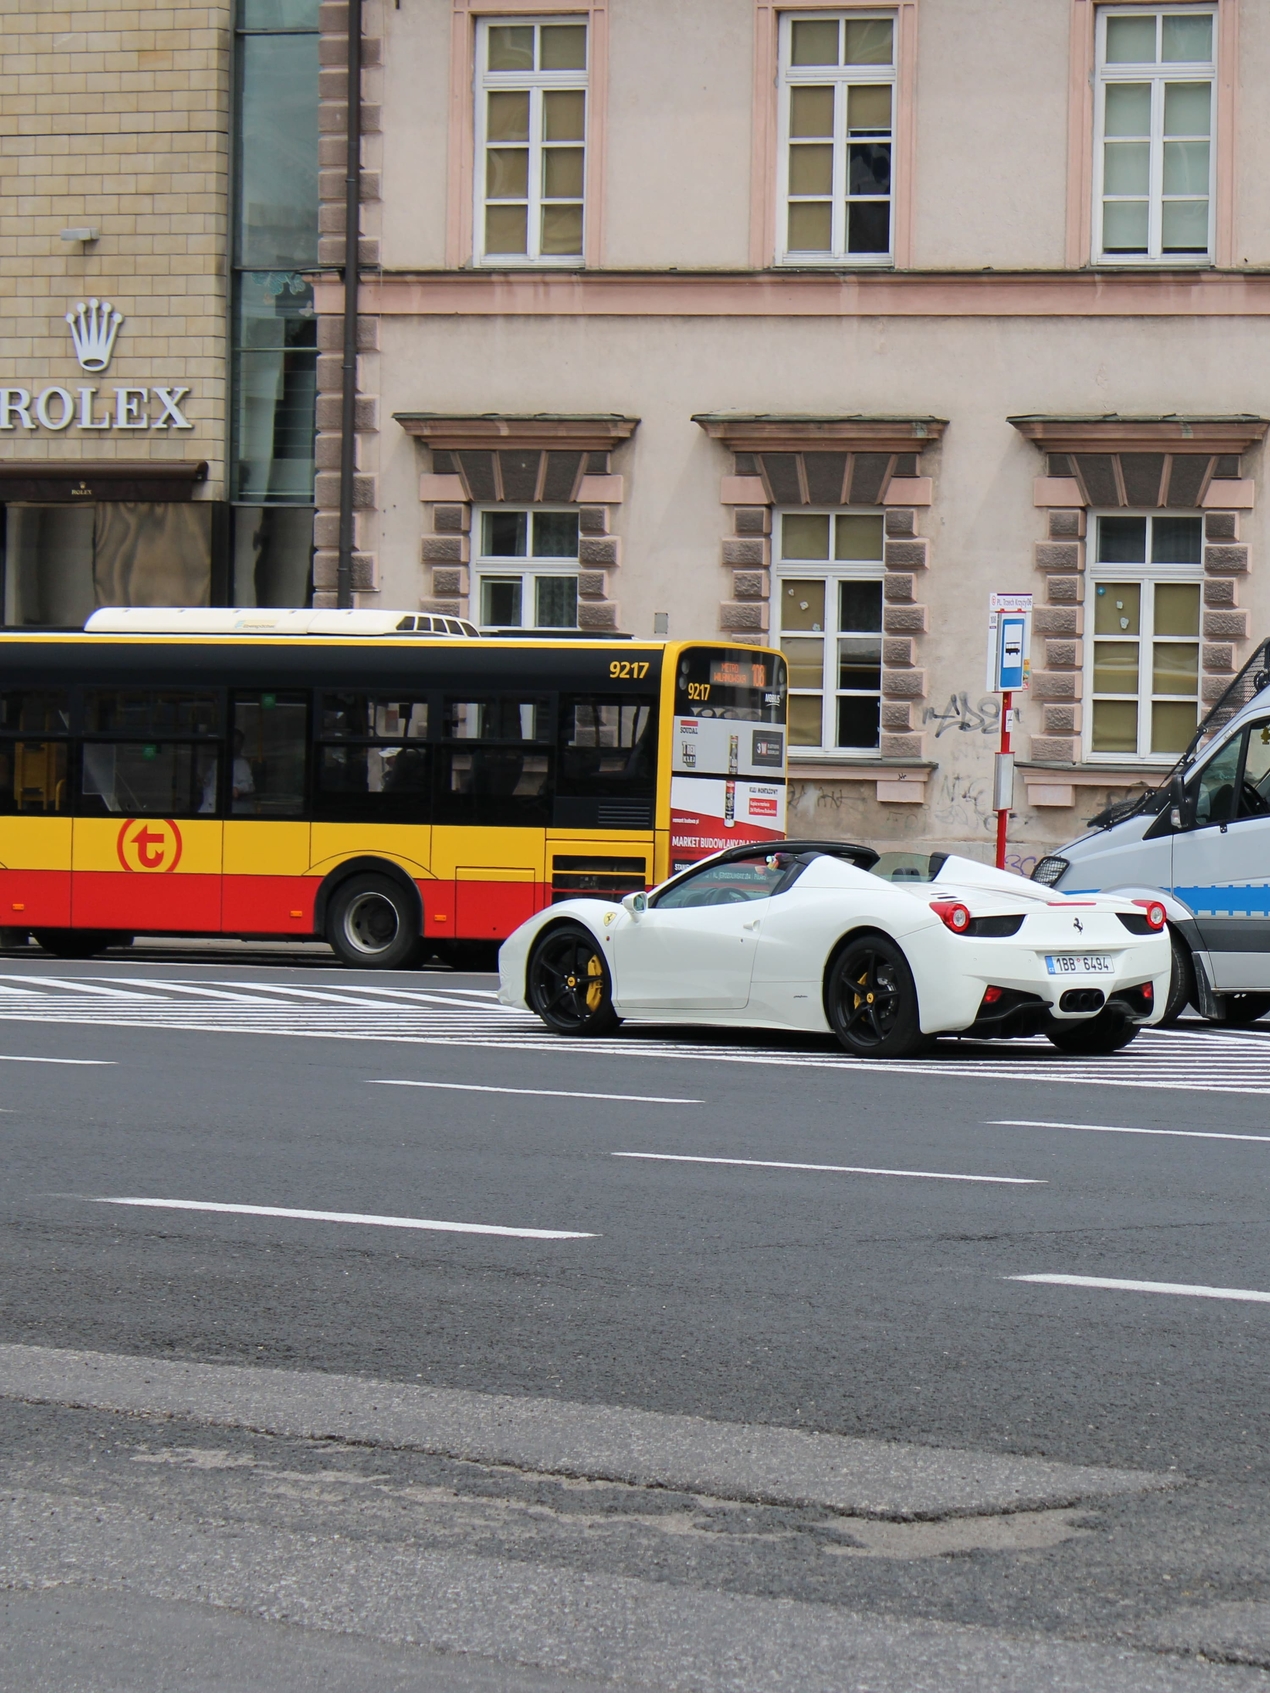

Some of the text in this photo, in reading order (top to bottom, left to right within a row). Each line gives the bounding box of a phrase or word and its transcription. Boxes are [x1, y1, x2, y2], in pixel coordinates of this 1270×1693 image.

[0, 386, 194, 431] ROLEX
[609, 661, 650, 679] 9217
[720, 662, 740, 674] METRO
[752, 663, 766, 688] 108
[687, 683, 711, 701] 9217
[671, 836, 700, 848] MARKET
[1056, 957, 1109, 972] 1BB 6494
